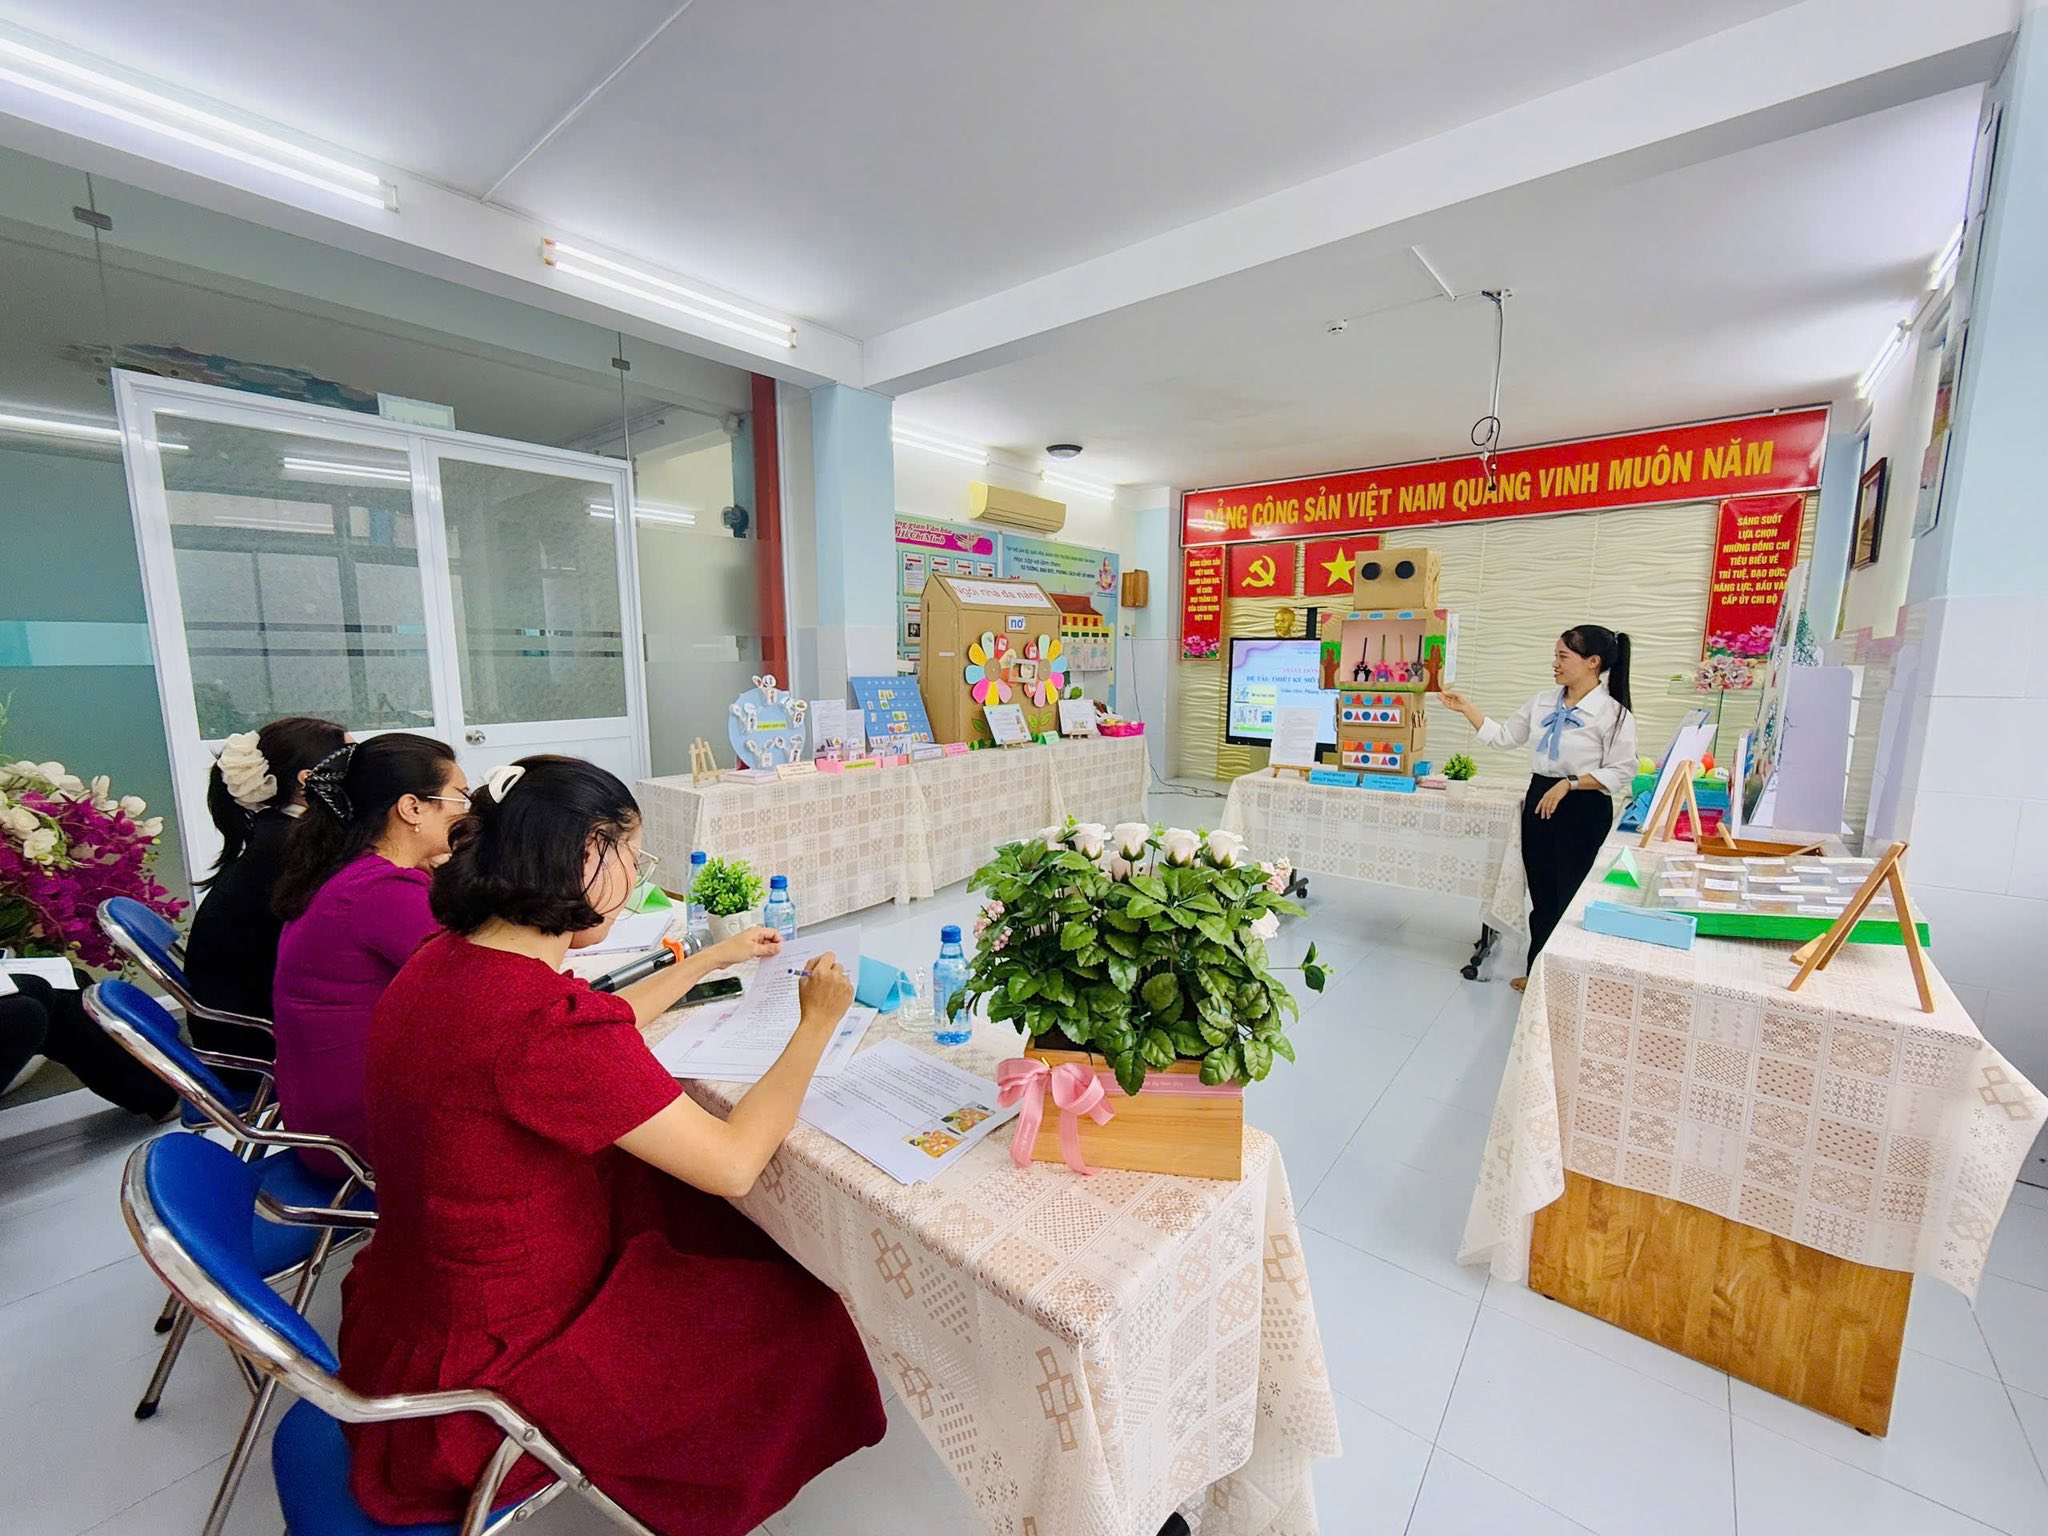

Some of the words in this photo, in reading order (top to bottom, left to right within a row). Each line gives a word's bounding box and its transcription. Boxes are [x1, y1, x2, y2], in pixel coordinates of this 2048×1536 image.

[1203, 498, 1248, 532] ĐẢNG
[1252, 495, 1299, 528] CỘNG
[1304, 486, 1342, 522] SẢN
[1347, 483, 1392, 522] VIỆT
[1399, 481, 1446, 513] NAM
[1452, 471, 1531, 512] QUANG
[1539, 462, 1600, 499] VINH
[1608, 445, 1692, 491] MUÔN
[1702, 437, 1774, 482] NĂM
[1737, 514, 1760, 526] SÁNG
[1738, 529, 1753, 540] LỰA
[1755, 529, 1778, 539] CHỌN
[1723, 541, 1750, 553] NHỮNG
[1752, 540, 1774, 552] ĐỒNG
[1776, 540, 1790, 550] CHÍ
[1730, 555, 1747, 566] TIÊU
[1751, 595, 1765, 604] CHI
